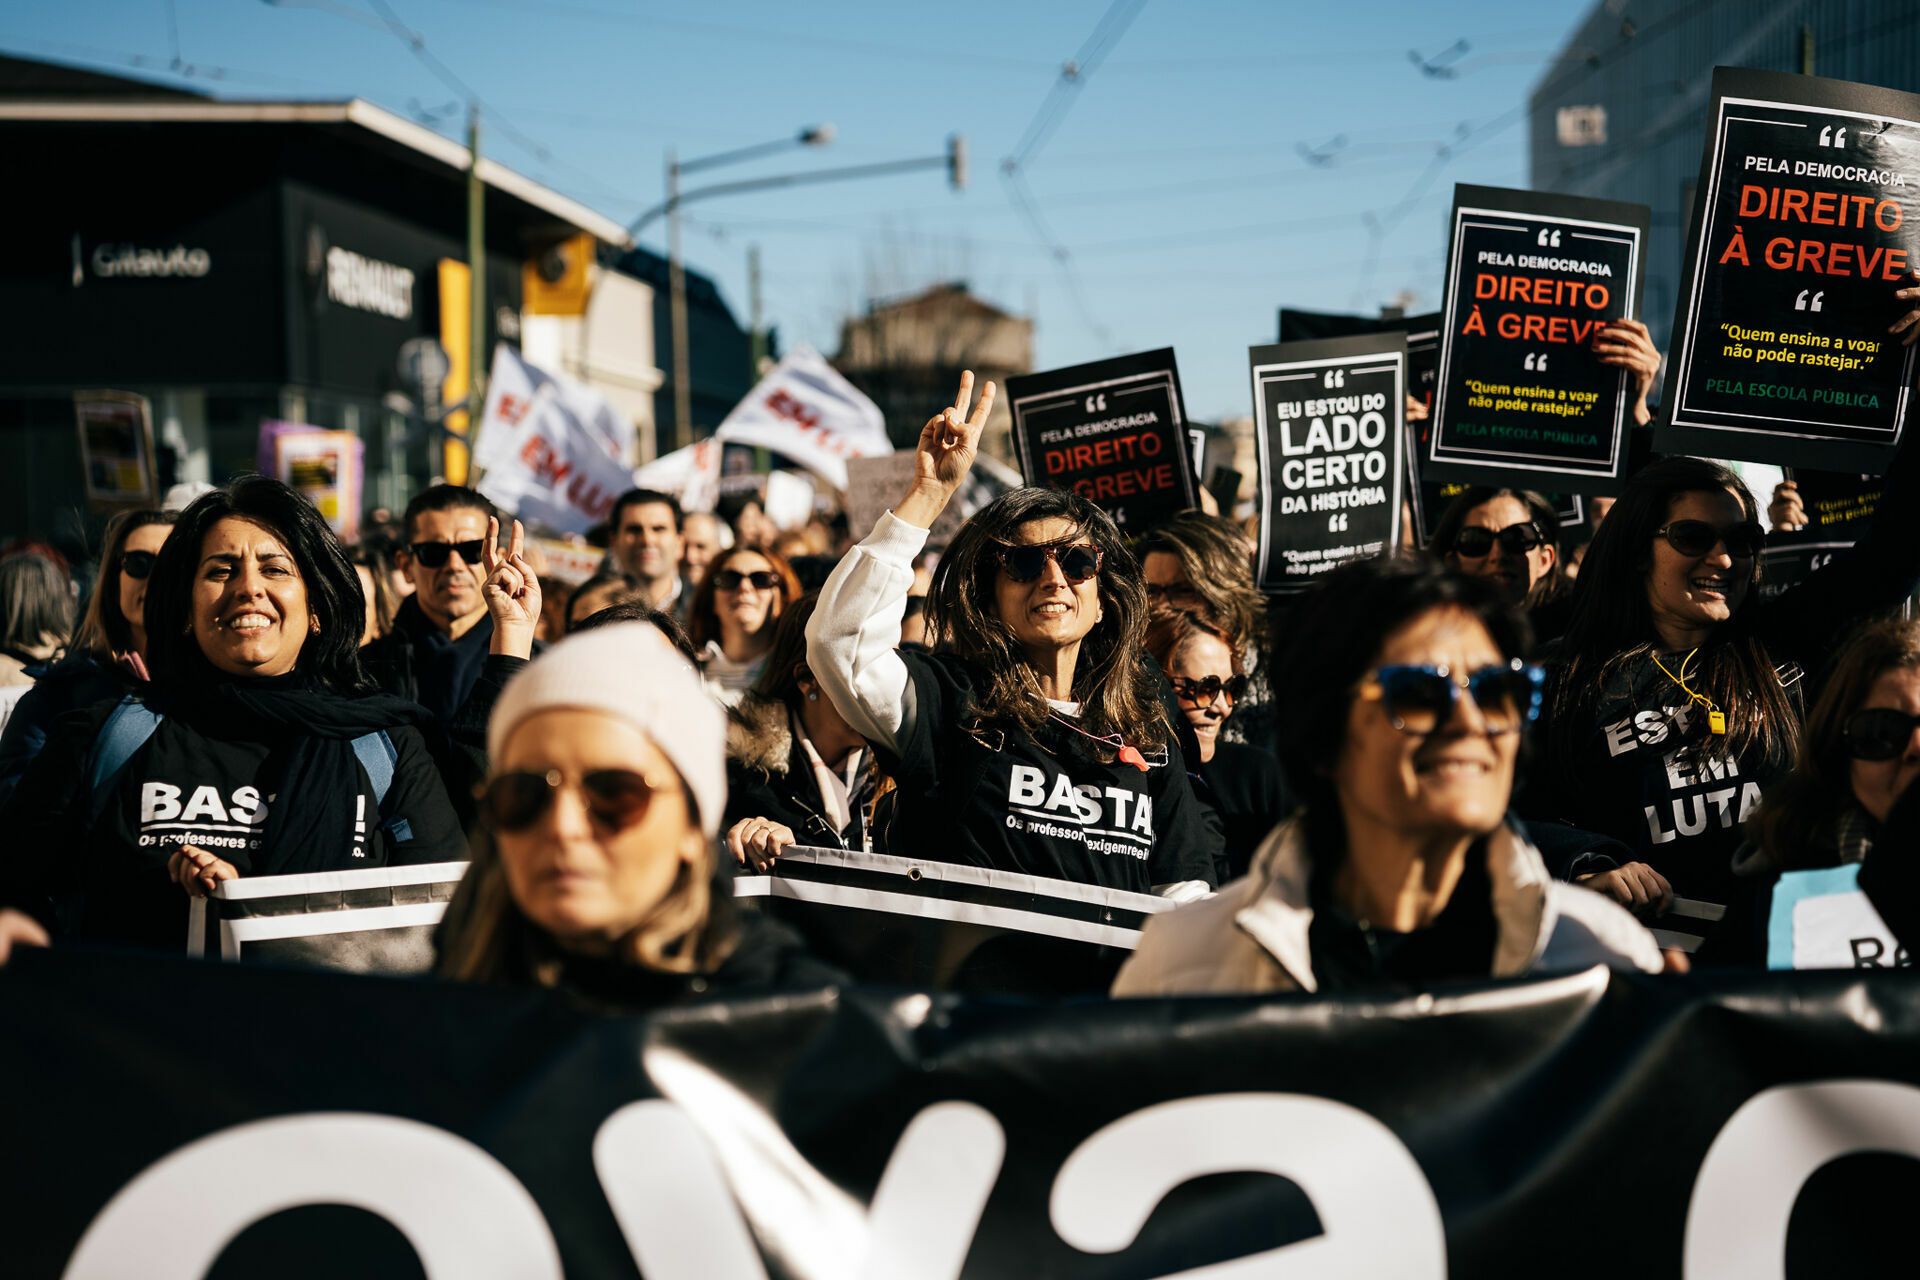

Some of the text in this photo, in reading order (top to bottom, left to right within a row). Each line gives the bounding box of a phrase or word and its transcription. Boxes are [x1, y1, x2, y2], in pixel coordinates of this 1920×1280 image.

[1744, 155, 1906, 188] PELA DEMOCRACIA
[1738, 184, 1904, 233] DIREITO
[1477, 251, 1613, 278] PELA DEMOCRACIA
[1719, 224, 1909, 281] À GREVE
[1474, 272, 1610, 311] DIREITO
[1461, 303, 1488, 337] À
[1723, 343, 1753, 360] não
[1756, 347, 1797, 364] pode
[1779, 332, 1831, 349] ensina
[1834, 340, 1844, 350] a
[1277, 392, 1386, 420] EU ESTOU DO
[1467, 395, 1493, 409] não
[1495, 397, 1529, 412] pode
[1513, 384, 1556, 401] ensina
[1558, 389, 1567, 401] a
[1569, 390, 1600, 403] voar
[1705, 377, 1881, 410] PELA ESCOLA PÚBLICA
[1040, 411, 1159, 445] PELA DEMOCRACIA
[1279, 411, 1387, 457] LADO
[1456, 422, 1488, 437] PELA
[1491, 425, 1540, 442] ESCOLA
[1044, 431, 1163, 476] DIREITO
[1073, 463, 1176, 501] GREVE
[1281, 450, 1387, 491] CERTO
[1281, 485, 1387, 515] DA HISTÓRIA
[1005, 814, 1024, 830] Os
[1644, 781, 1763, 845] LUTA
[138, 834, 157, 847] Os
